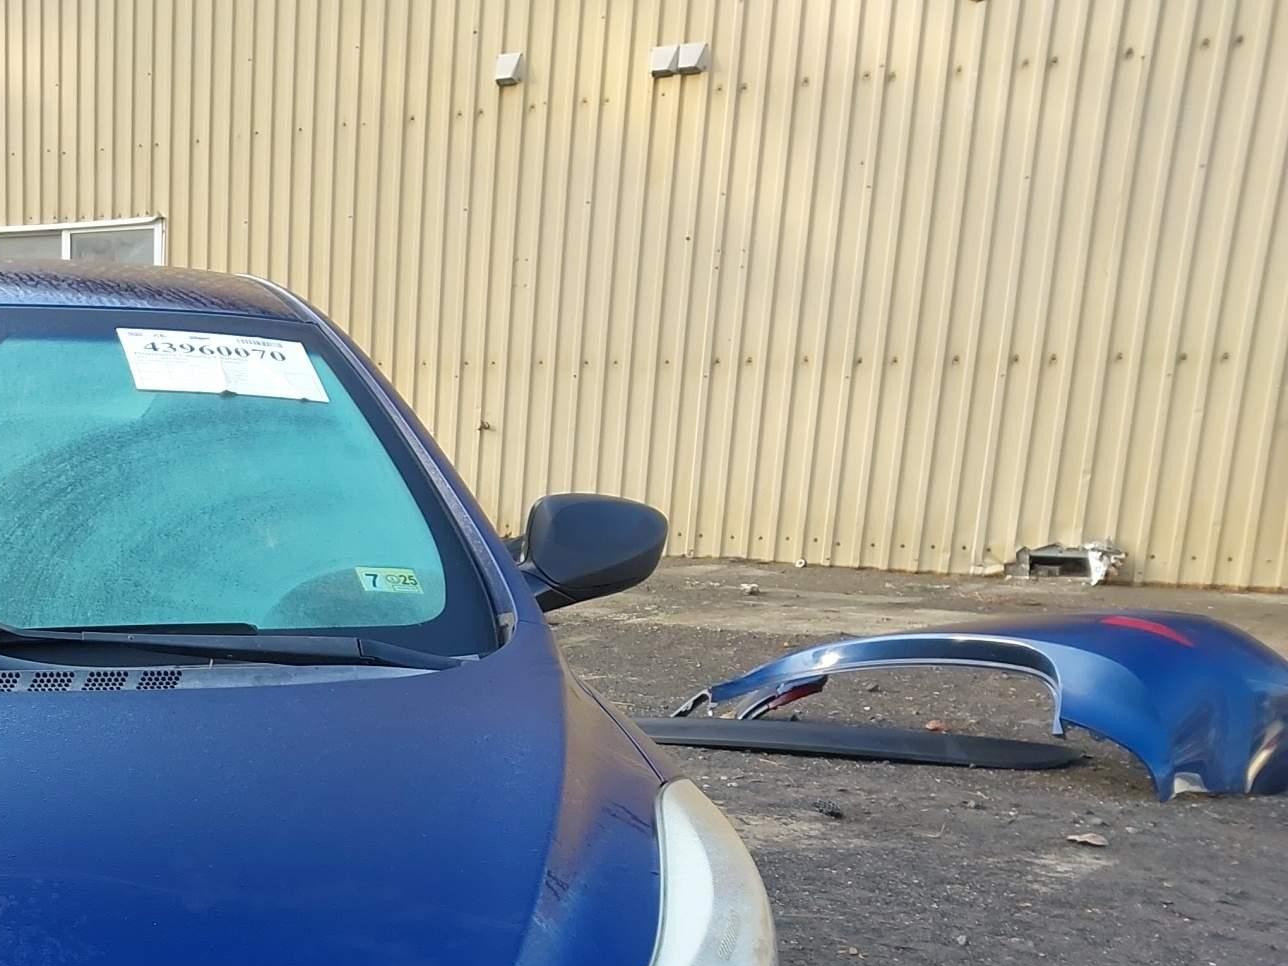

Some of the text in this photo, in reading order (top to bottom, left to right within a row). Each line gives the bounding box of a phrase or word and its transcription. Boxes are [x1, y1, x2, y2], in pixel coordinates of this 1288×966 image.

[143, 341, 286, 362] 43960070
[365, 573, 418, 588] 7 25
